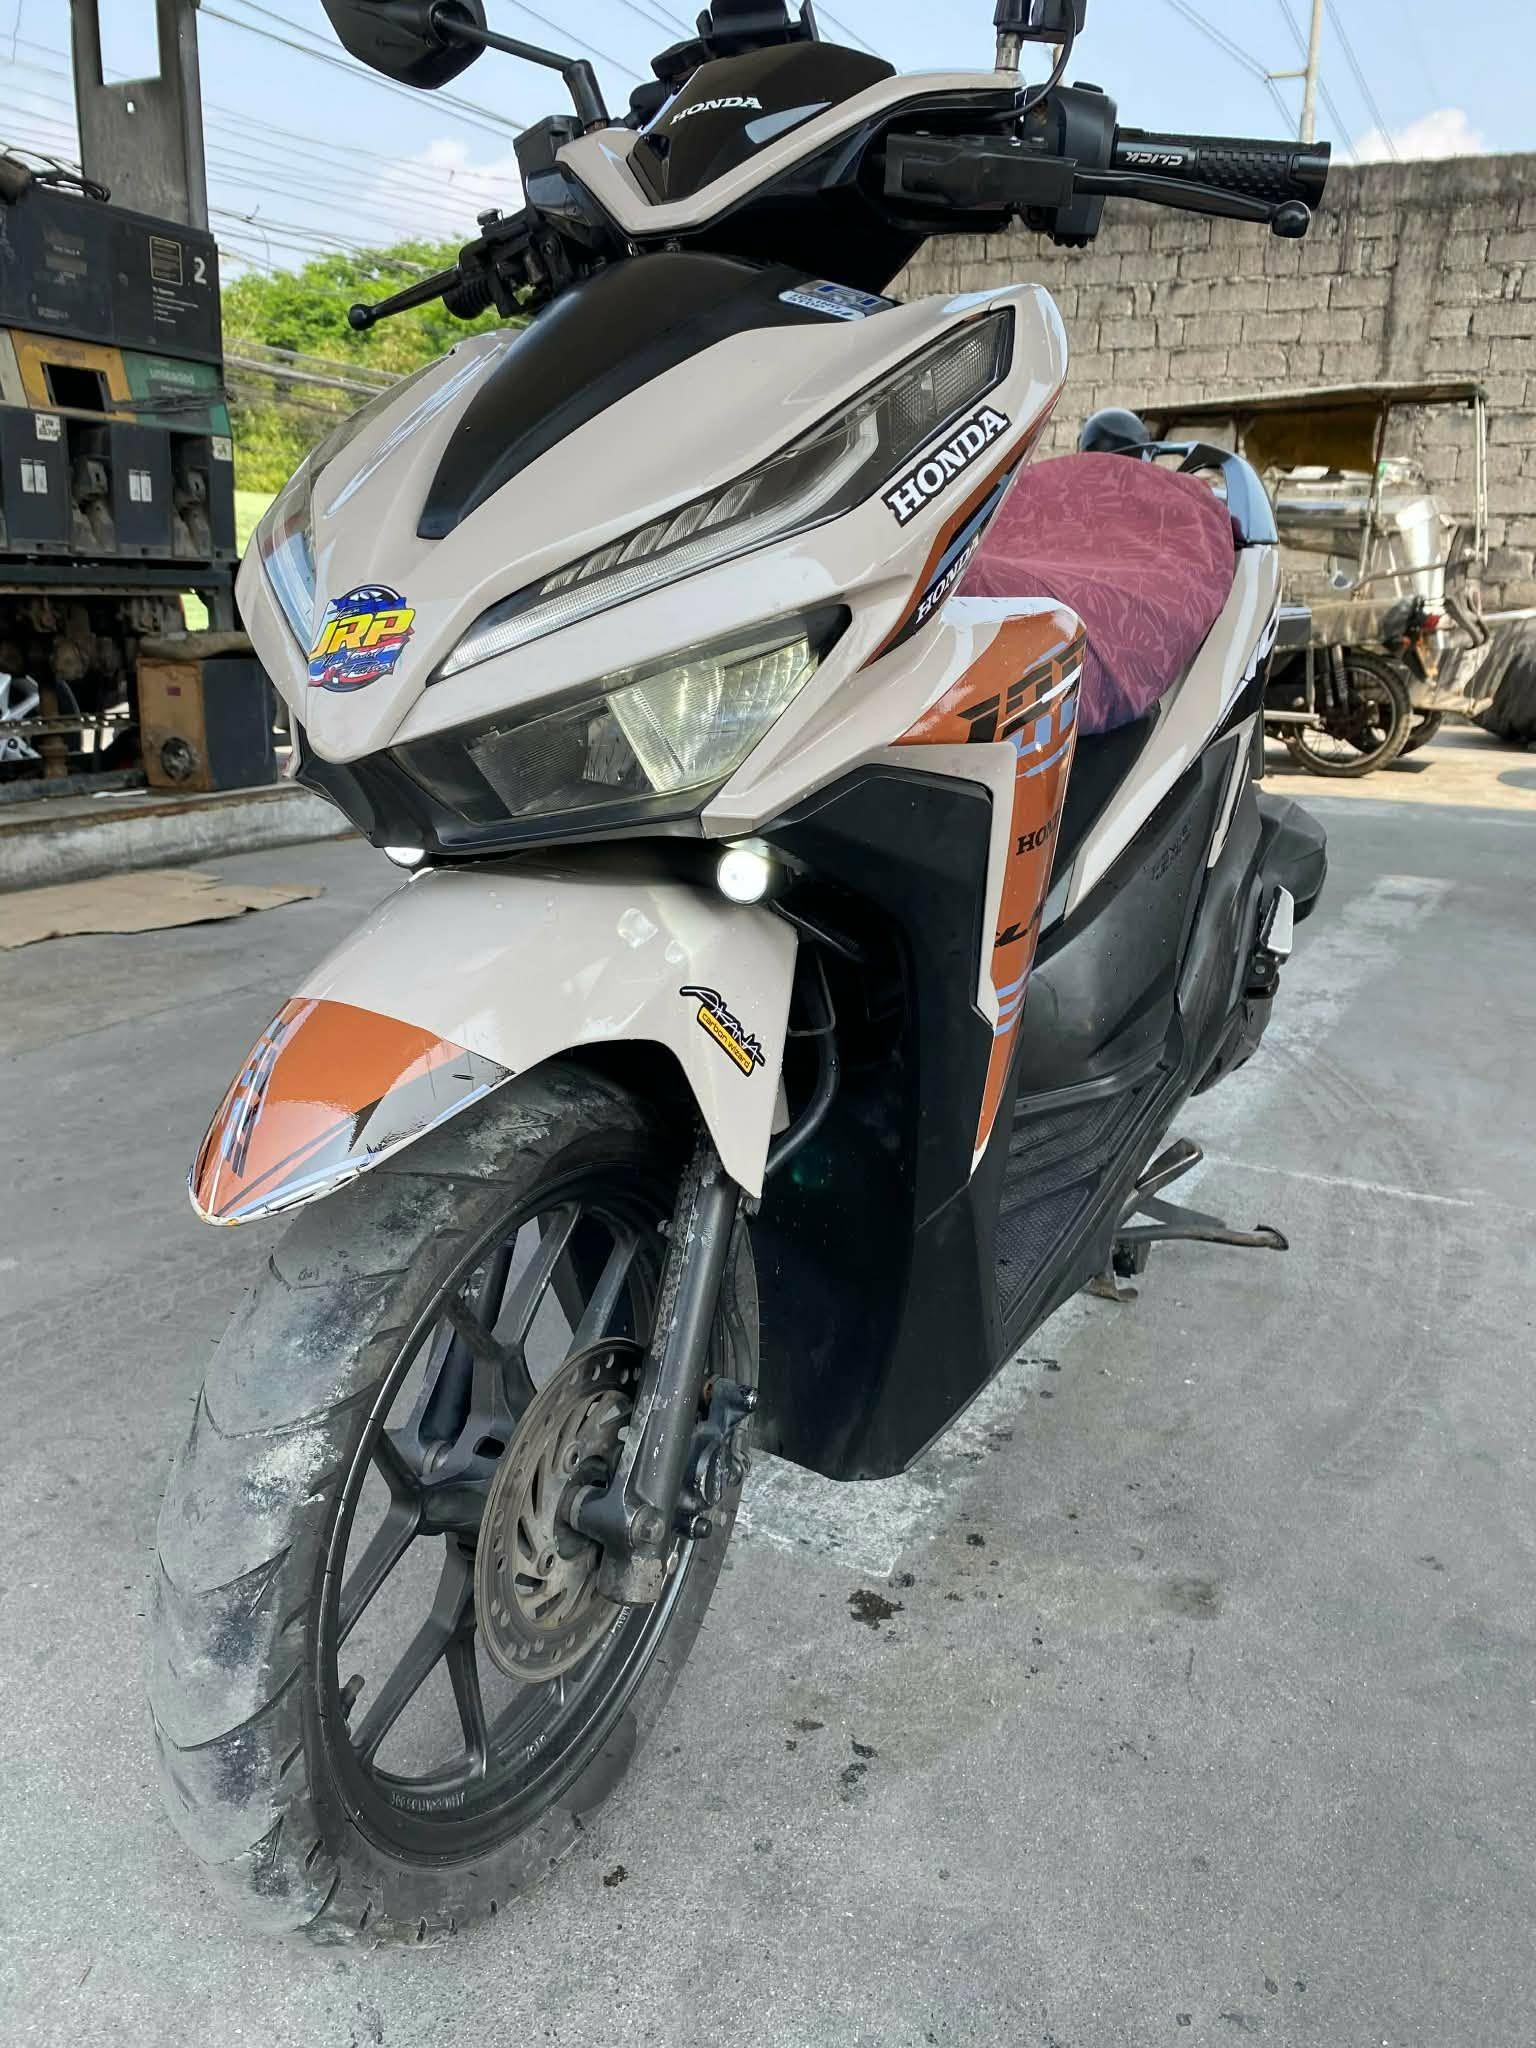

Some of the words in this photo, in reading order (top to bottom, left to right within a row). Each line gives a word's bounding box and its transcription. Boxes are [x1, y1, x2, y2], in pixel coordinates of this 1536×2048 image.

[669, 95, 763, 126] HONDA
[1125, 151, 1184, 166] CLICK
[193, 256, 208, 285] 2
[887, 408, 1008, 521] HONDA
[915, 534, 980, 624] HONDA
[307, 608, 416, 661] JRP
[1015, 808, 1061, 856] HON
[701, 1011, 728, 1044] carbon
[727, 1038, 752, 1069] wizard
